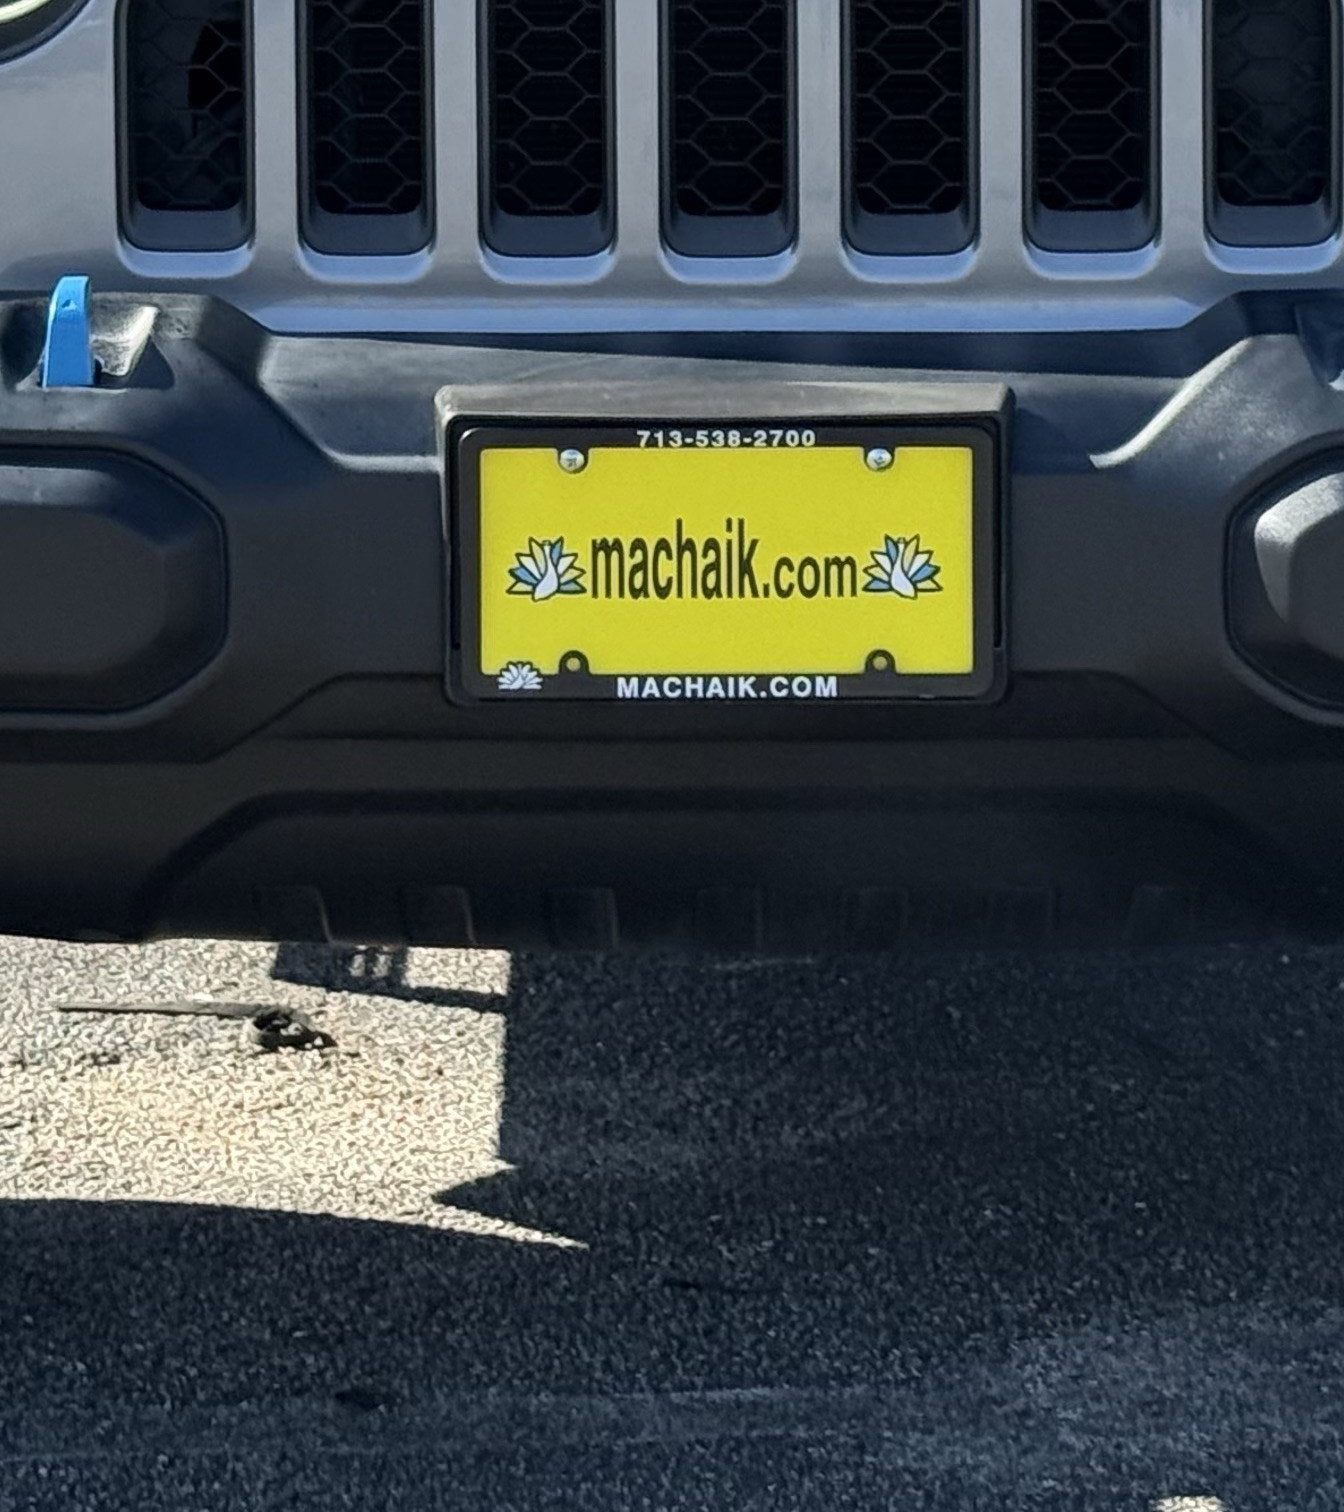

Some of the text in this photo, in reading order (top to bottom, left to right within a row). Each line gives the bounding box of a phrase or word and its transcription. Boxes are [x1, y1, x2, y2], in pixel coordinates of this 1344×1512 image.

[637, 430, 816, 448] 713-538-2700
[590, 518, 858, 599] machaik.com
[617, 676, 838, 699] MACHAIK.COM
